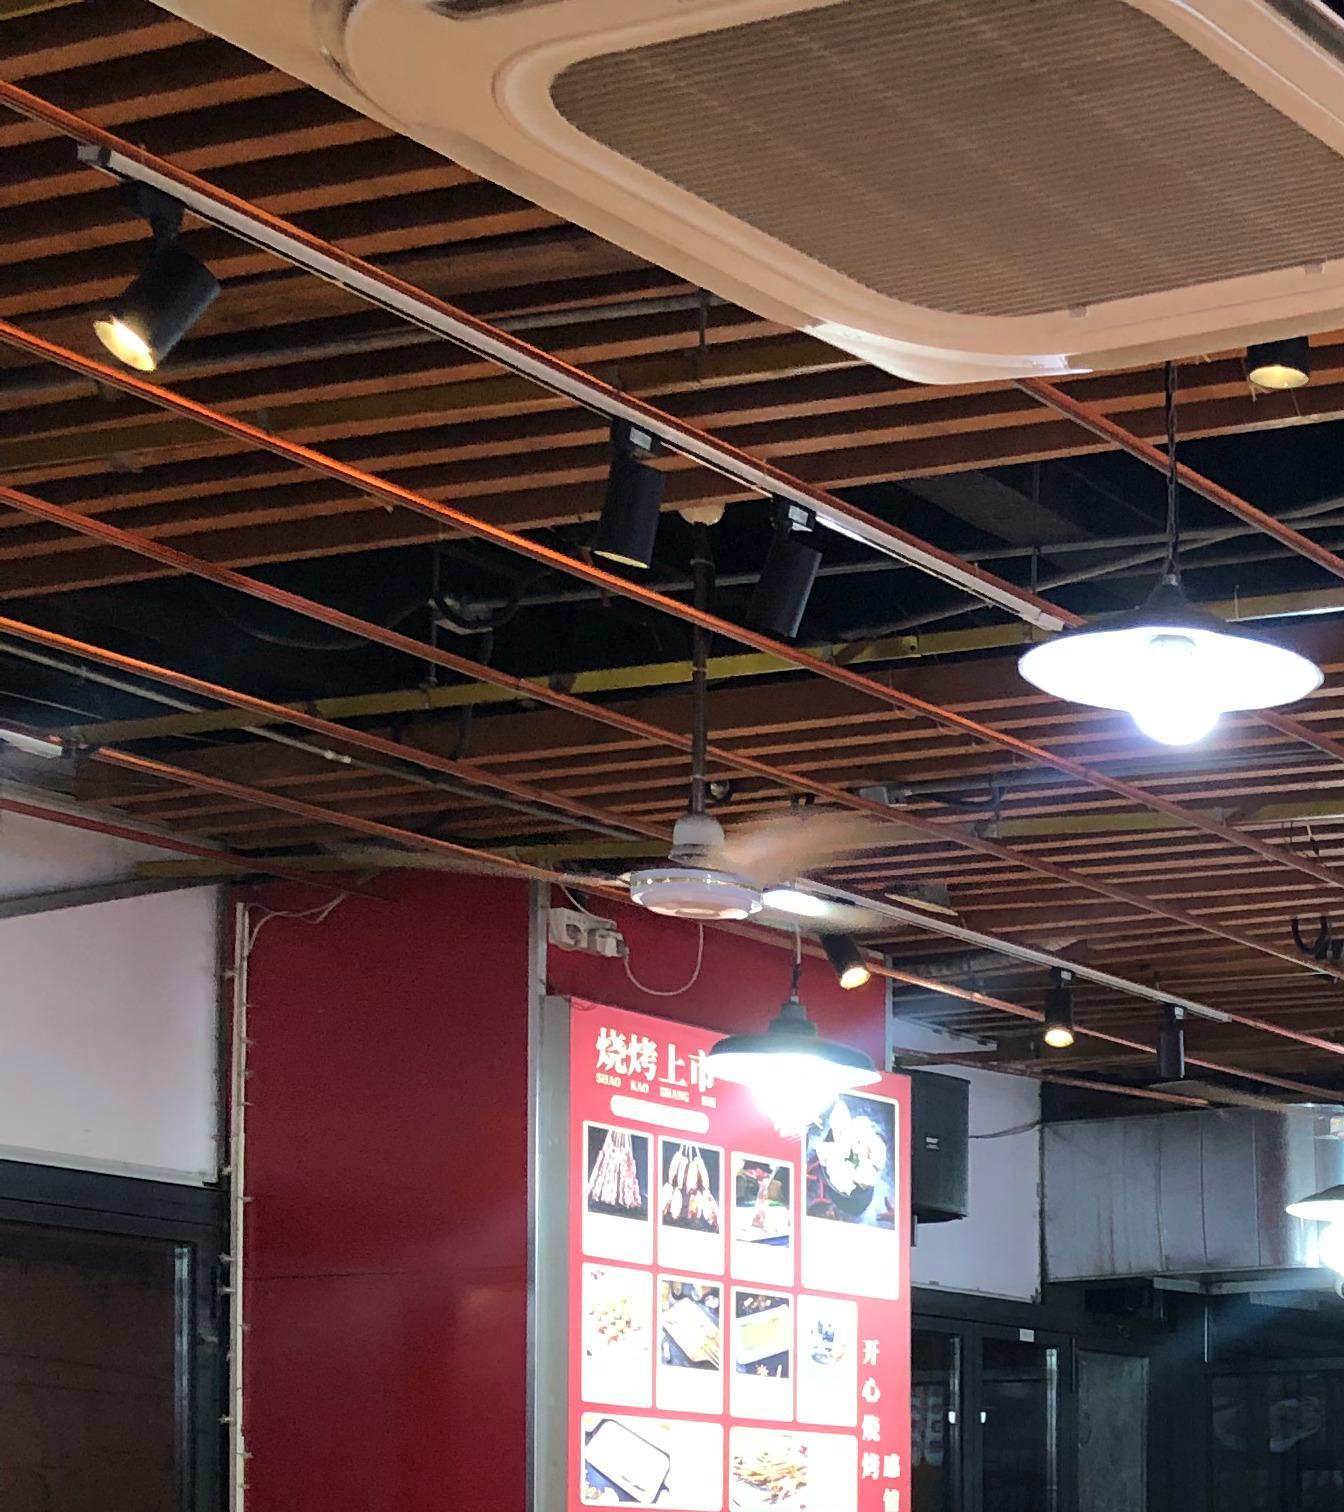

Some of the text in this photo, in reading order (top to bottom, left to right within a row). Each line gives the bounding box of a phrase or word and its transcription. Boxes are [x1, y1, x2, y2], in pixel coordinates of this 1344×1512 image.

[595, 1027, 716, 1092] 烧烤上市
[861, 1338, 882, 1481] 开心烧烤
